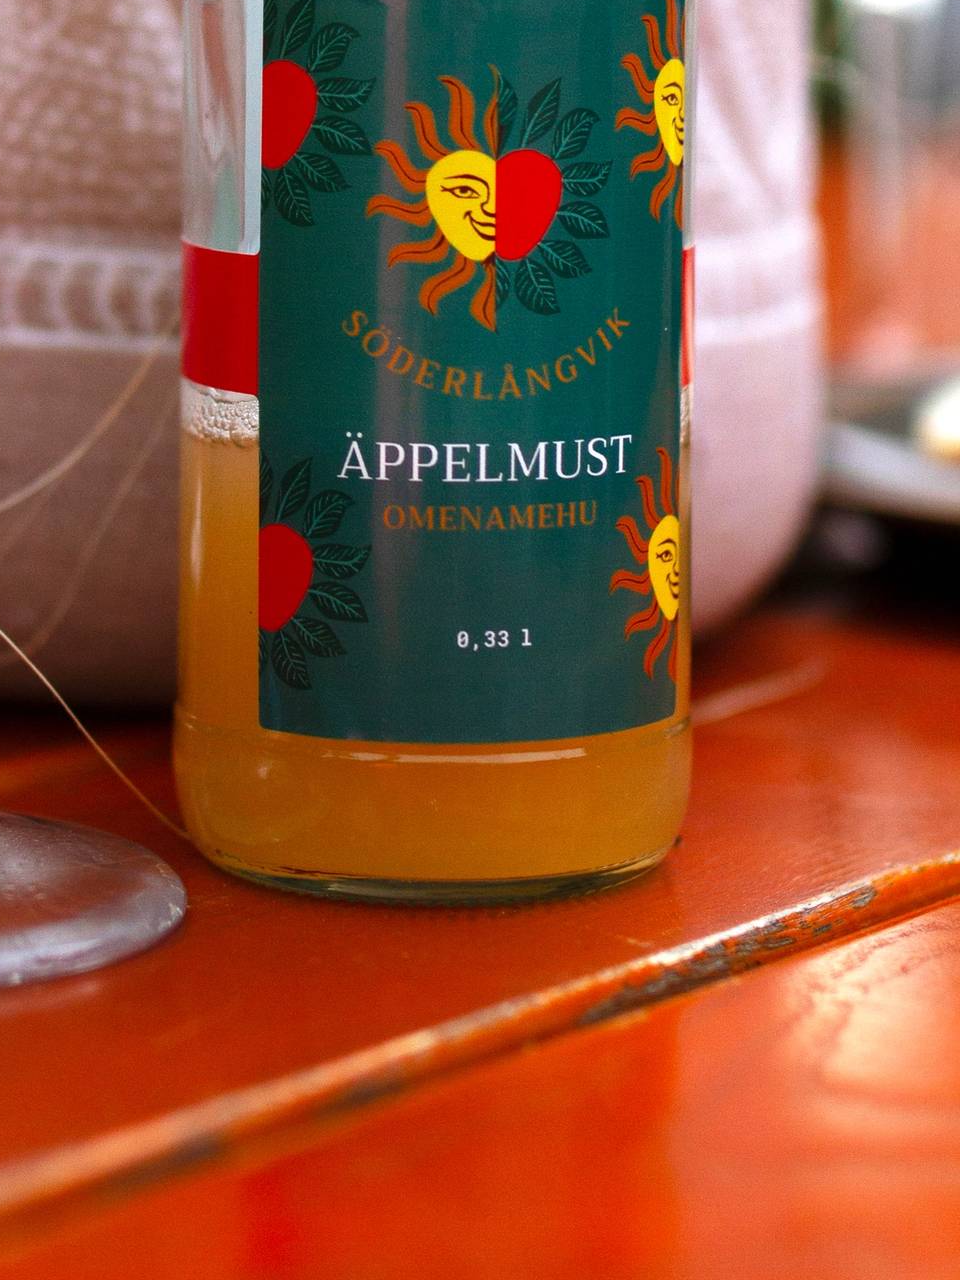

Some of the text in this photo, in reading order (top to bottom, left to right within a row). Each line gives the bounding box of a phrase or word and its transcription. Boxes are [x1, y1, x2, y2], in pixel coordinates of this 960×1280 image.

[342, 307, 631, 400] SÖDERLÅNGVIK
[336, 431, 632, 482] ÄPPELMUST
[383, 499, 598, 531] OMENAMEHU
[456, 630, 509, 652] 0,33
